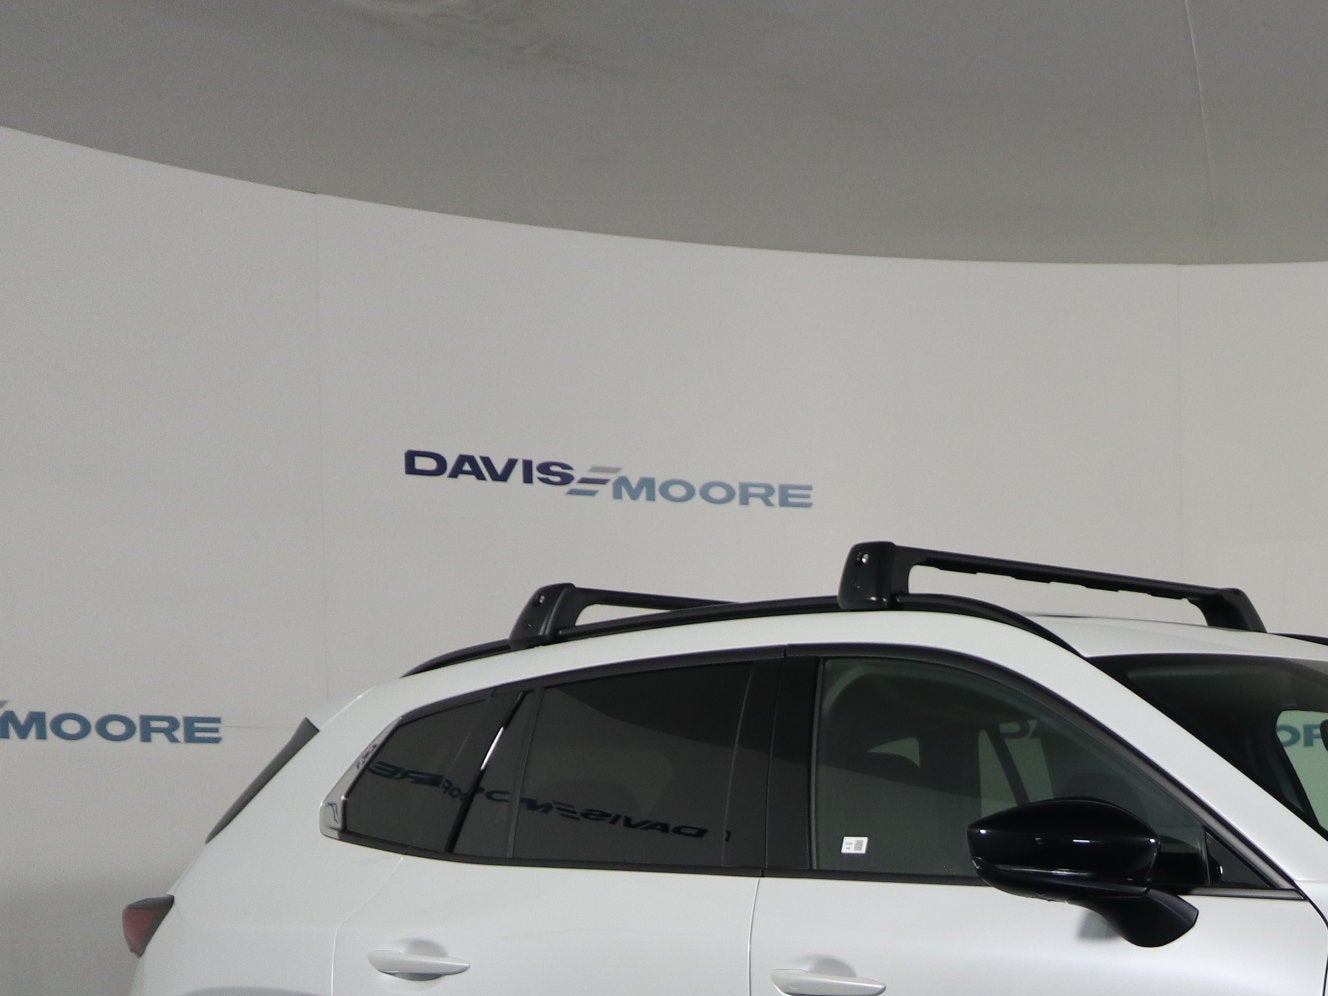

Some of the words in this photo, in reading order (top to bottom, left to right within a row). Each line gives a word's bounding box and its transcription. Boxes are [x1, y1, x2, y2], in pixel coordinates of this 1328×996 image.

[404, 449, 575, 486] DAVIS
[612, 474, 815, 508] MOORE
[0, 710, 223, 744] MOORE
